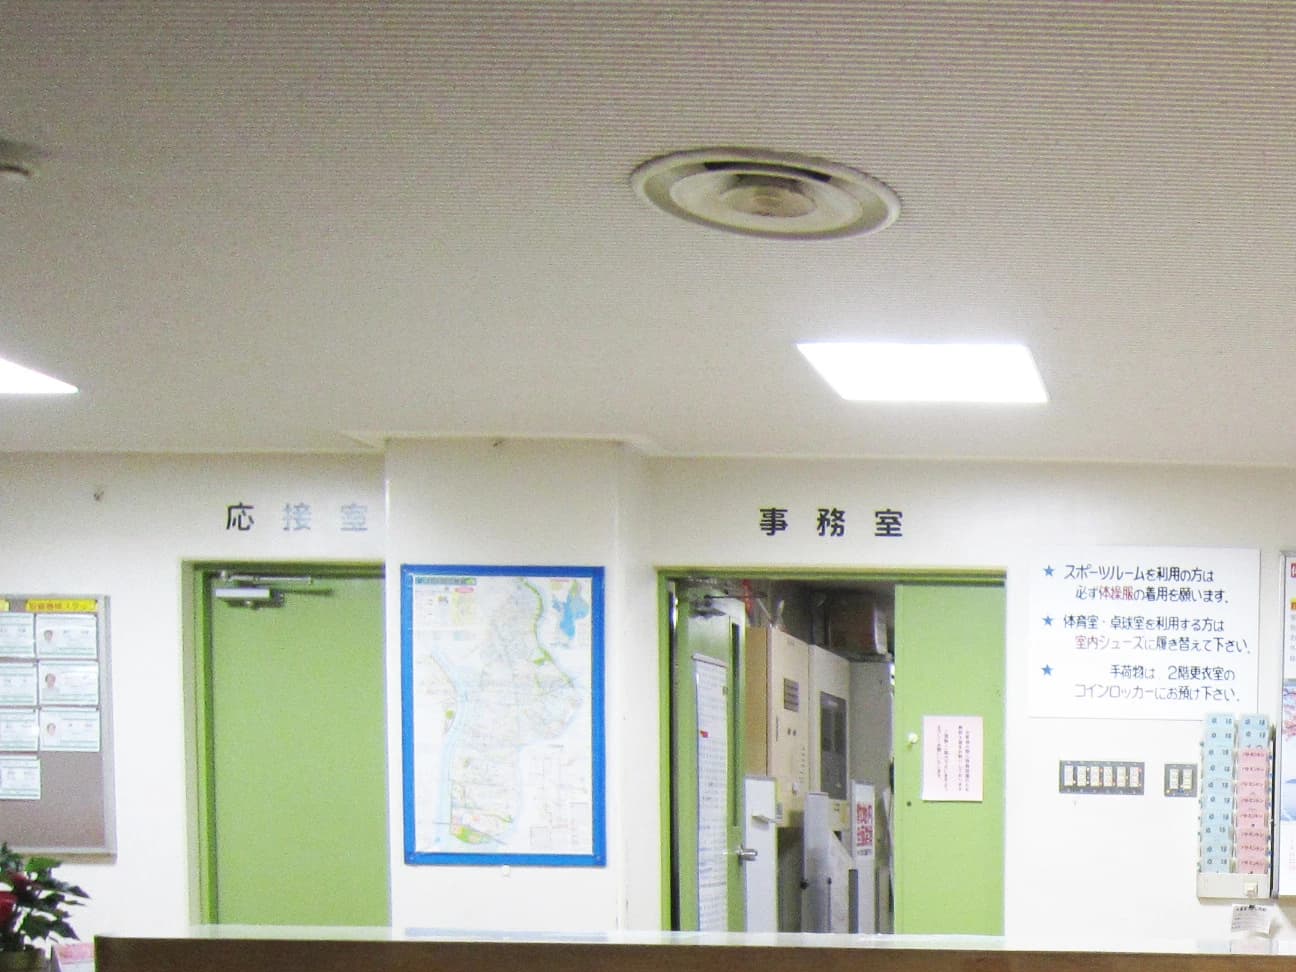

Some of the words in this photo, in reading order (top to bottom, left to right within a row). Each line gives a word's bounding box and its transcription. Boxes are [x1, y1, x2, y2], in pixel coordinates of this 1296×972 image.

[226, 503, 369, 532] 応接室
[759, 507, 903, 537] 事務室
[1063, 564, 1214, 583] スポーツルームを利用の方は
[1074, 635, 1251, 654] 室内シューズに履き替えて下さい。
